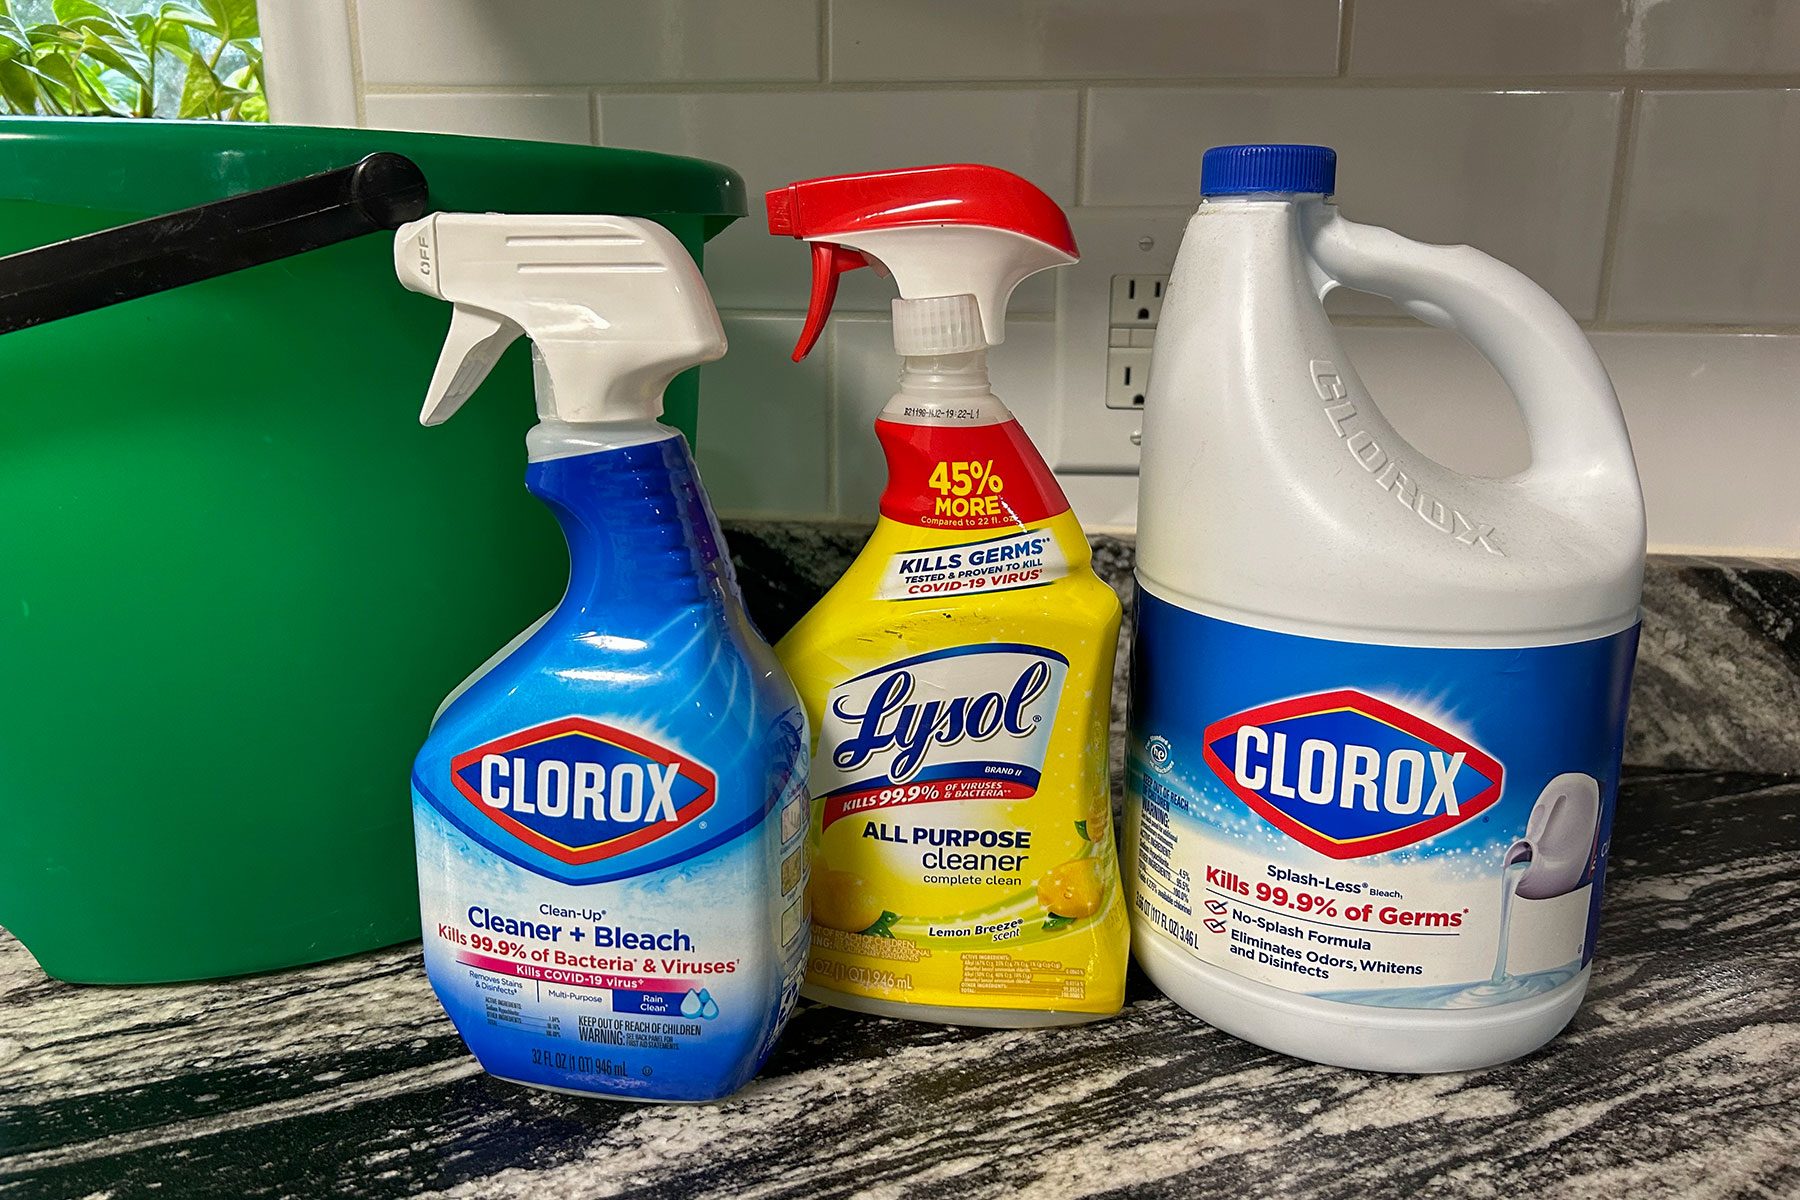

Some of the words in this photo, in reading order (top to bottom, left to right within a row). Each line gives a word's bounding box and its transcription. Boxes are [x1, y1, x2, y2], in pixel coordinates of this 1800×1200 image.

[418, 236, 430, 275] OFF
[1309, 354, 1506, 557] CLOROX
[928, 460, 1004, 496] 45%
[935, 495, 1001, 517] MORE
[921, 515, 963, 526] Compared
[966, 518, 975, 526] to
[978, 517, 989, 526] 22
[992, 516, 1001, 524] fl.
[899, 554, 962, 575] KILLS
[905, 573, 945, 584] TESTED
[958, 566, 1003, 579] PROVEN
[1006, 562, 1020, 572] TO
[1023, 558, 1043, 569] KILL
[908, 577, 986, 595] COVID-19
[832, 660, 1050, 780] Lysol
[984, 766, 1014, 776] BRAND
[1234, 725, 1467, 817] CLOROX
[480, 753, 682, 823] CLOROX
[843, 795, 877, 812] KILLS
[879, 785, 939, 806] 99.9%
[945, 783, 957, 791] OF
[960, 781, 1003, 790] VIRUSES
[1171, 792, 1189, 812] REACH
[863, 821, 908, 843] ALL
[913, 827, 1031, 849] PURPOSE
[922, 848, 1029, 871] cleaner
[923, 875, 982, 887] complete
[985, 875, 1022, 886] clean
[1206, 865, 1250, 896] Kills
[1256, 882, 1337, 918] 99.9%
[1344, 904, 1373, 922] of
[468, 906, 562, 942] Cleaner
[569, 926, 585, 942] +
[928, 927, 971, 937] Lemon
[993, 928, 1020, 942] scent
[1161, 914, 1168, 931] FL
[1180, 925, 1194, 947] 3.46
[1194, 933, 1199, 950] L
[1232, 908, 1304, 939] No-Splash
[1308, 930, 1371, 951] Formula
[438, 922, 467, 946] Kills
[470, 933, 527, 959] 99.9%
[531, 948, 549, 963] of
[642, 958, 657, 974] &
[863, 933, 873, 944] OF
[875, 937, 916, 950] CHILDREN
[1231, 928, 1302, 959] Eliminates
[1306, 951, 1357, 972] Odors,
[1360, 958, 1423, 975] Whitens
[1230, 943, 1255, 960] and
[1258, 951, 1330, 979] Disinfects
[469, 970, 500, 985] Removes
[501, 978, 523, 989] Stains
[475, 980, 481, 988] &
[516, 964, 541, 977] Kills
[544, 969, 603, 986] COVID-19
[873, 971, 894, 988] 946
[897, 975, 913, 990] mL
[548, 989, 603, 1003] Multi-Purpose
[643, 995, 663, 1004] Rain
[578, 1015, 597, 1027] KEEP
[598, 1017, 613, 1029] OUT
[614, 1019, 624, 1030] OF
[625, 1021, 650, 1033] REACH
[651, 1022, 662, 1033] OF
[662, 1023, 702, 1036] CHILDREN
[578, 1026, 626, 1046] WARNING:
[531, 1048, 542, 1065] 32
[544, 1050, 554, 1067] FL
[556, 1052, 567, 1069] OZ
[596, 1057, 612, 1076] 946
[614, 1060, 629, 1077] mL
